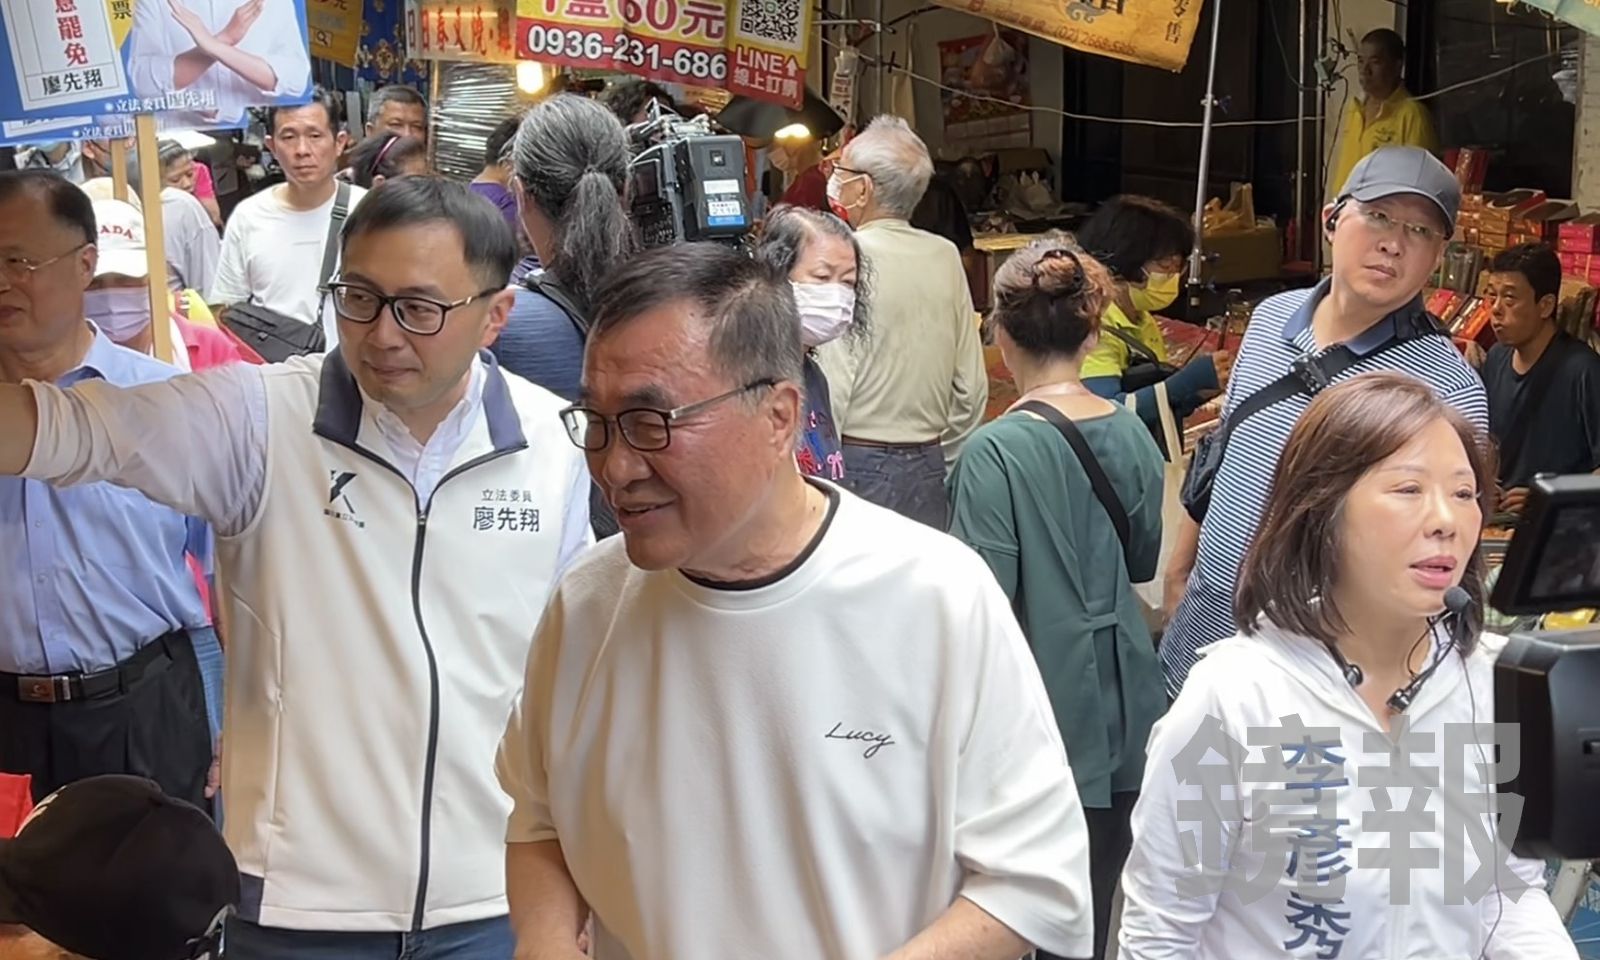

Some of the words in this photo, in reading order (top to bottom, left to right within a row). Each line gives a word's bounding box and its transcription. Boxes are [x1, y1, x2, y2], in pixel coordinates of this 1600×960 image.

[528, 25, 727, 80] 0936-231-686
[736, 45, 783, 75] LINE
[41, 68, 104, 95] 廖先翔
[733, 66, 798, 99] 線上訂購
[481, 489, 532, 502] 立法委員
[473, 506, 540, 532] 廖先翔
[824, 721, 895, 759] Lucy
